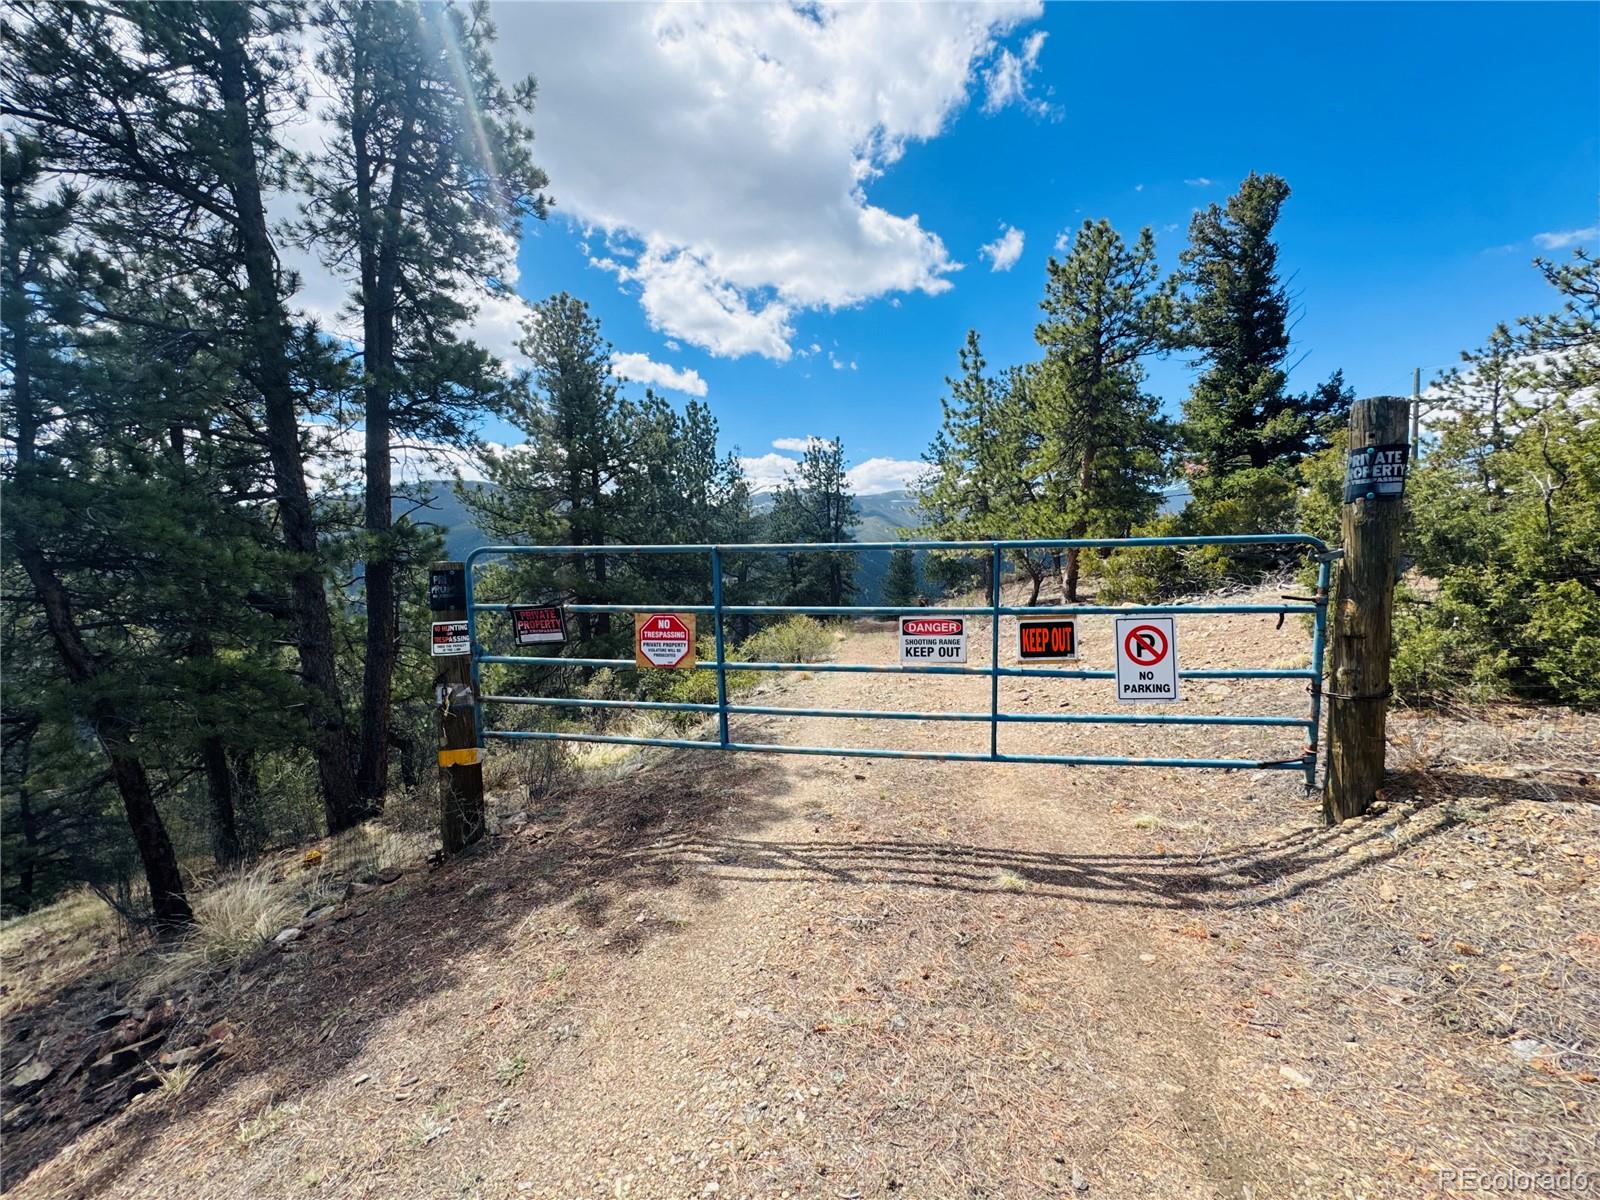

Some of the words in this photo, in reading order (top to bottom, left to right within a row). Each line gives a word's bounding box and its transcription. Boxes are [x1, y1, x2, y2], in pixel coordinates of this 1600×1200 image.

[519, 607, 557, 620] PRIVATE
[441, 624, 468, 632] HUNTING
[518, 619, 561, 630] PROPERTY
[658, 619, 670, 629] NO
[908, 622, 957, 632] DANGER
[643, 631, 686, 639] TRESPASSING
[1022, 628, 1049, 652] KEEP
[1051, 627, 1071, 652] OUT
[938, 638, 961, 646] RANGE
[905, 646, 935, 658] KEEP
[938, 646, 961, 658] OUT
[1139, 671, 1154, 680] NO
[1124, 684, 1170, 693] PARKING
